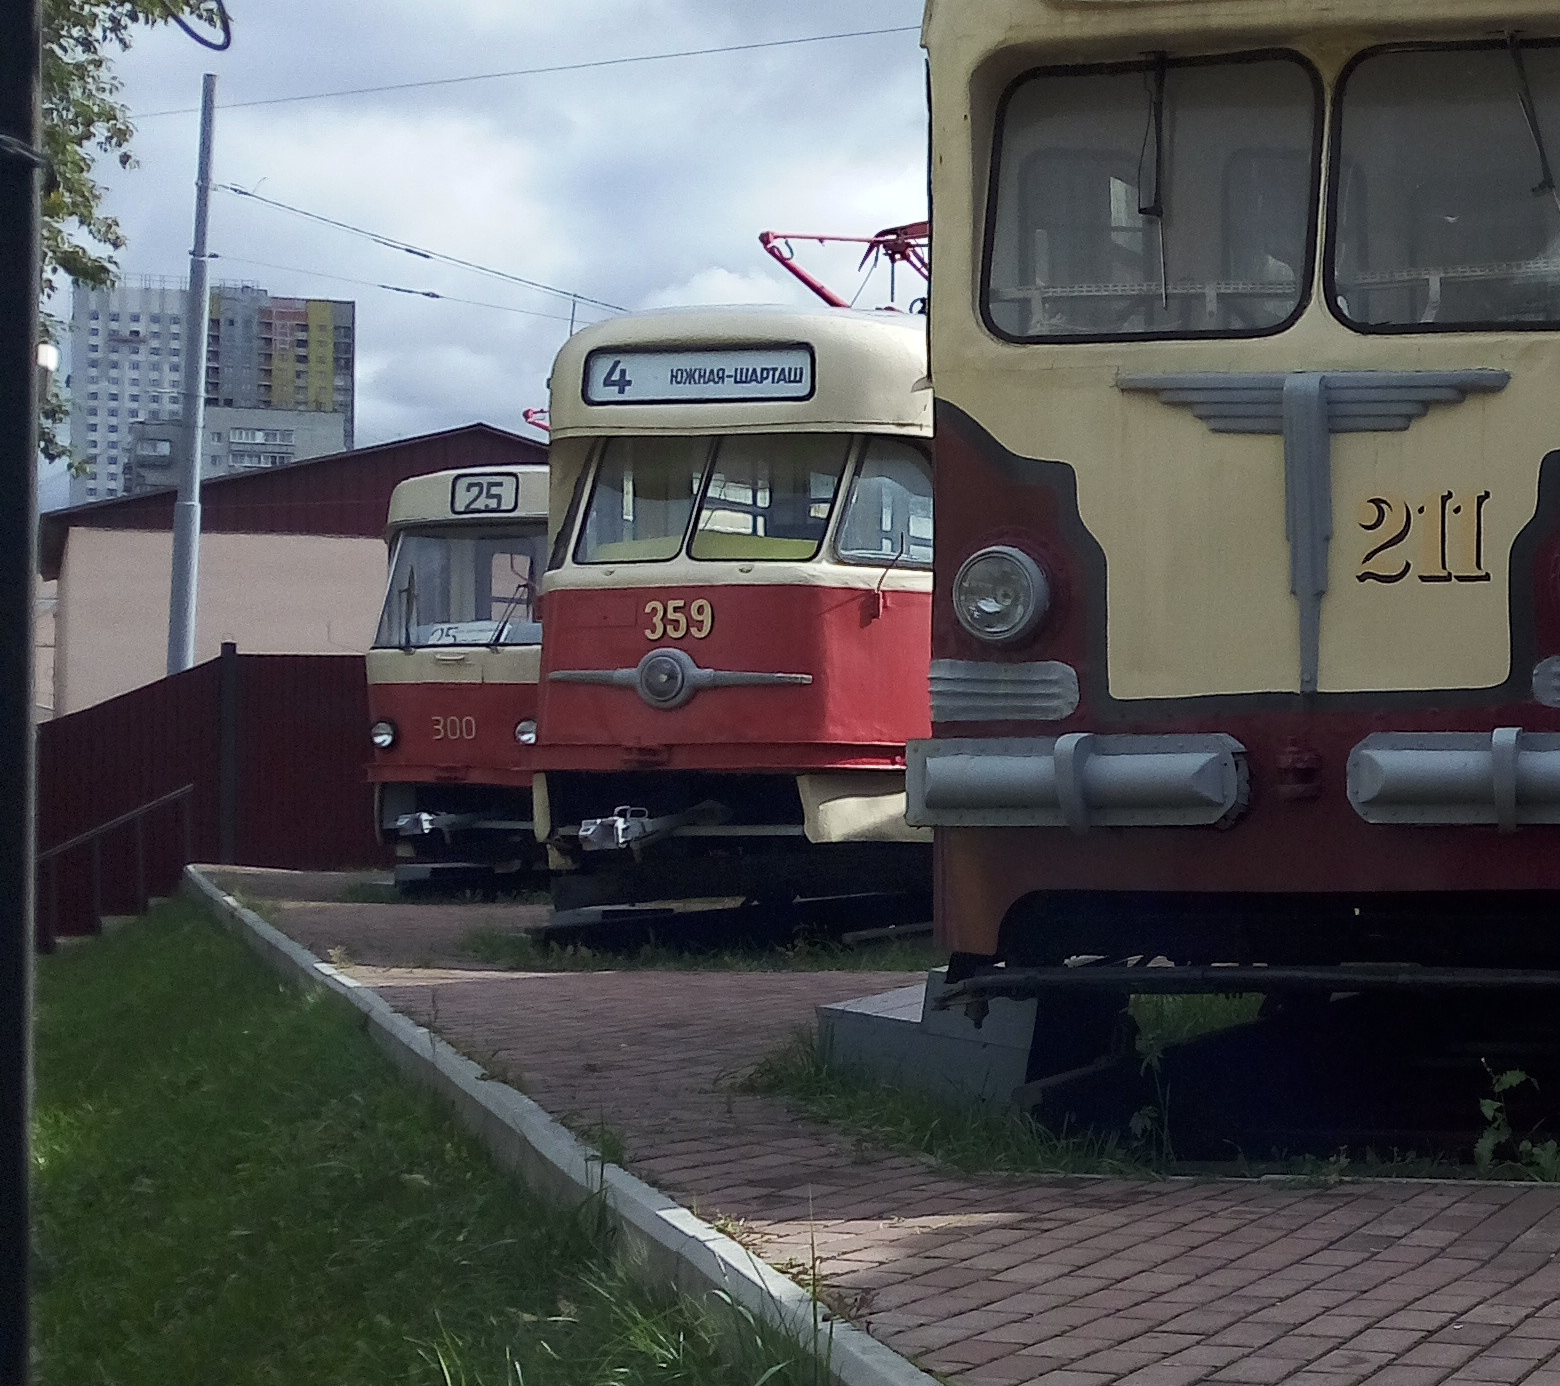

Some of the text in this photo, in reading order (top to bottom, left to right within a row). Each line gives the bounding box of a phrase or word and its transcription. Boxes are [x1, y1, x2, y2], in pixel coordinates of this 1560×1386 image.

[602, 359, 803, 394] 4 ЮЖНАЯ-ШАРТАШ
[464, 481, 504, 511] 25
[1355, 489, 1491, 584] 211
[644, 598, 714, 641] 359
[431, 716, 476, 740] 300
